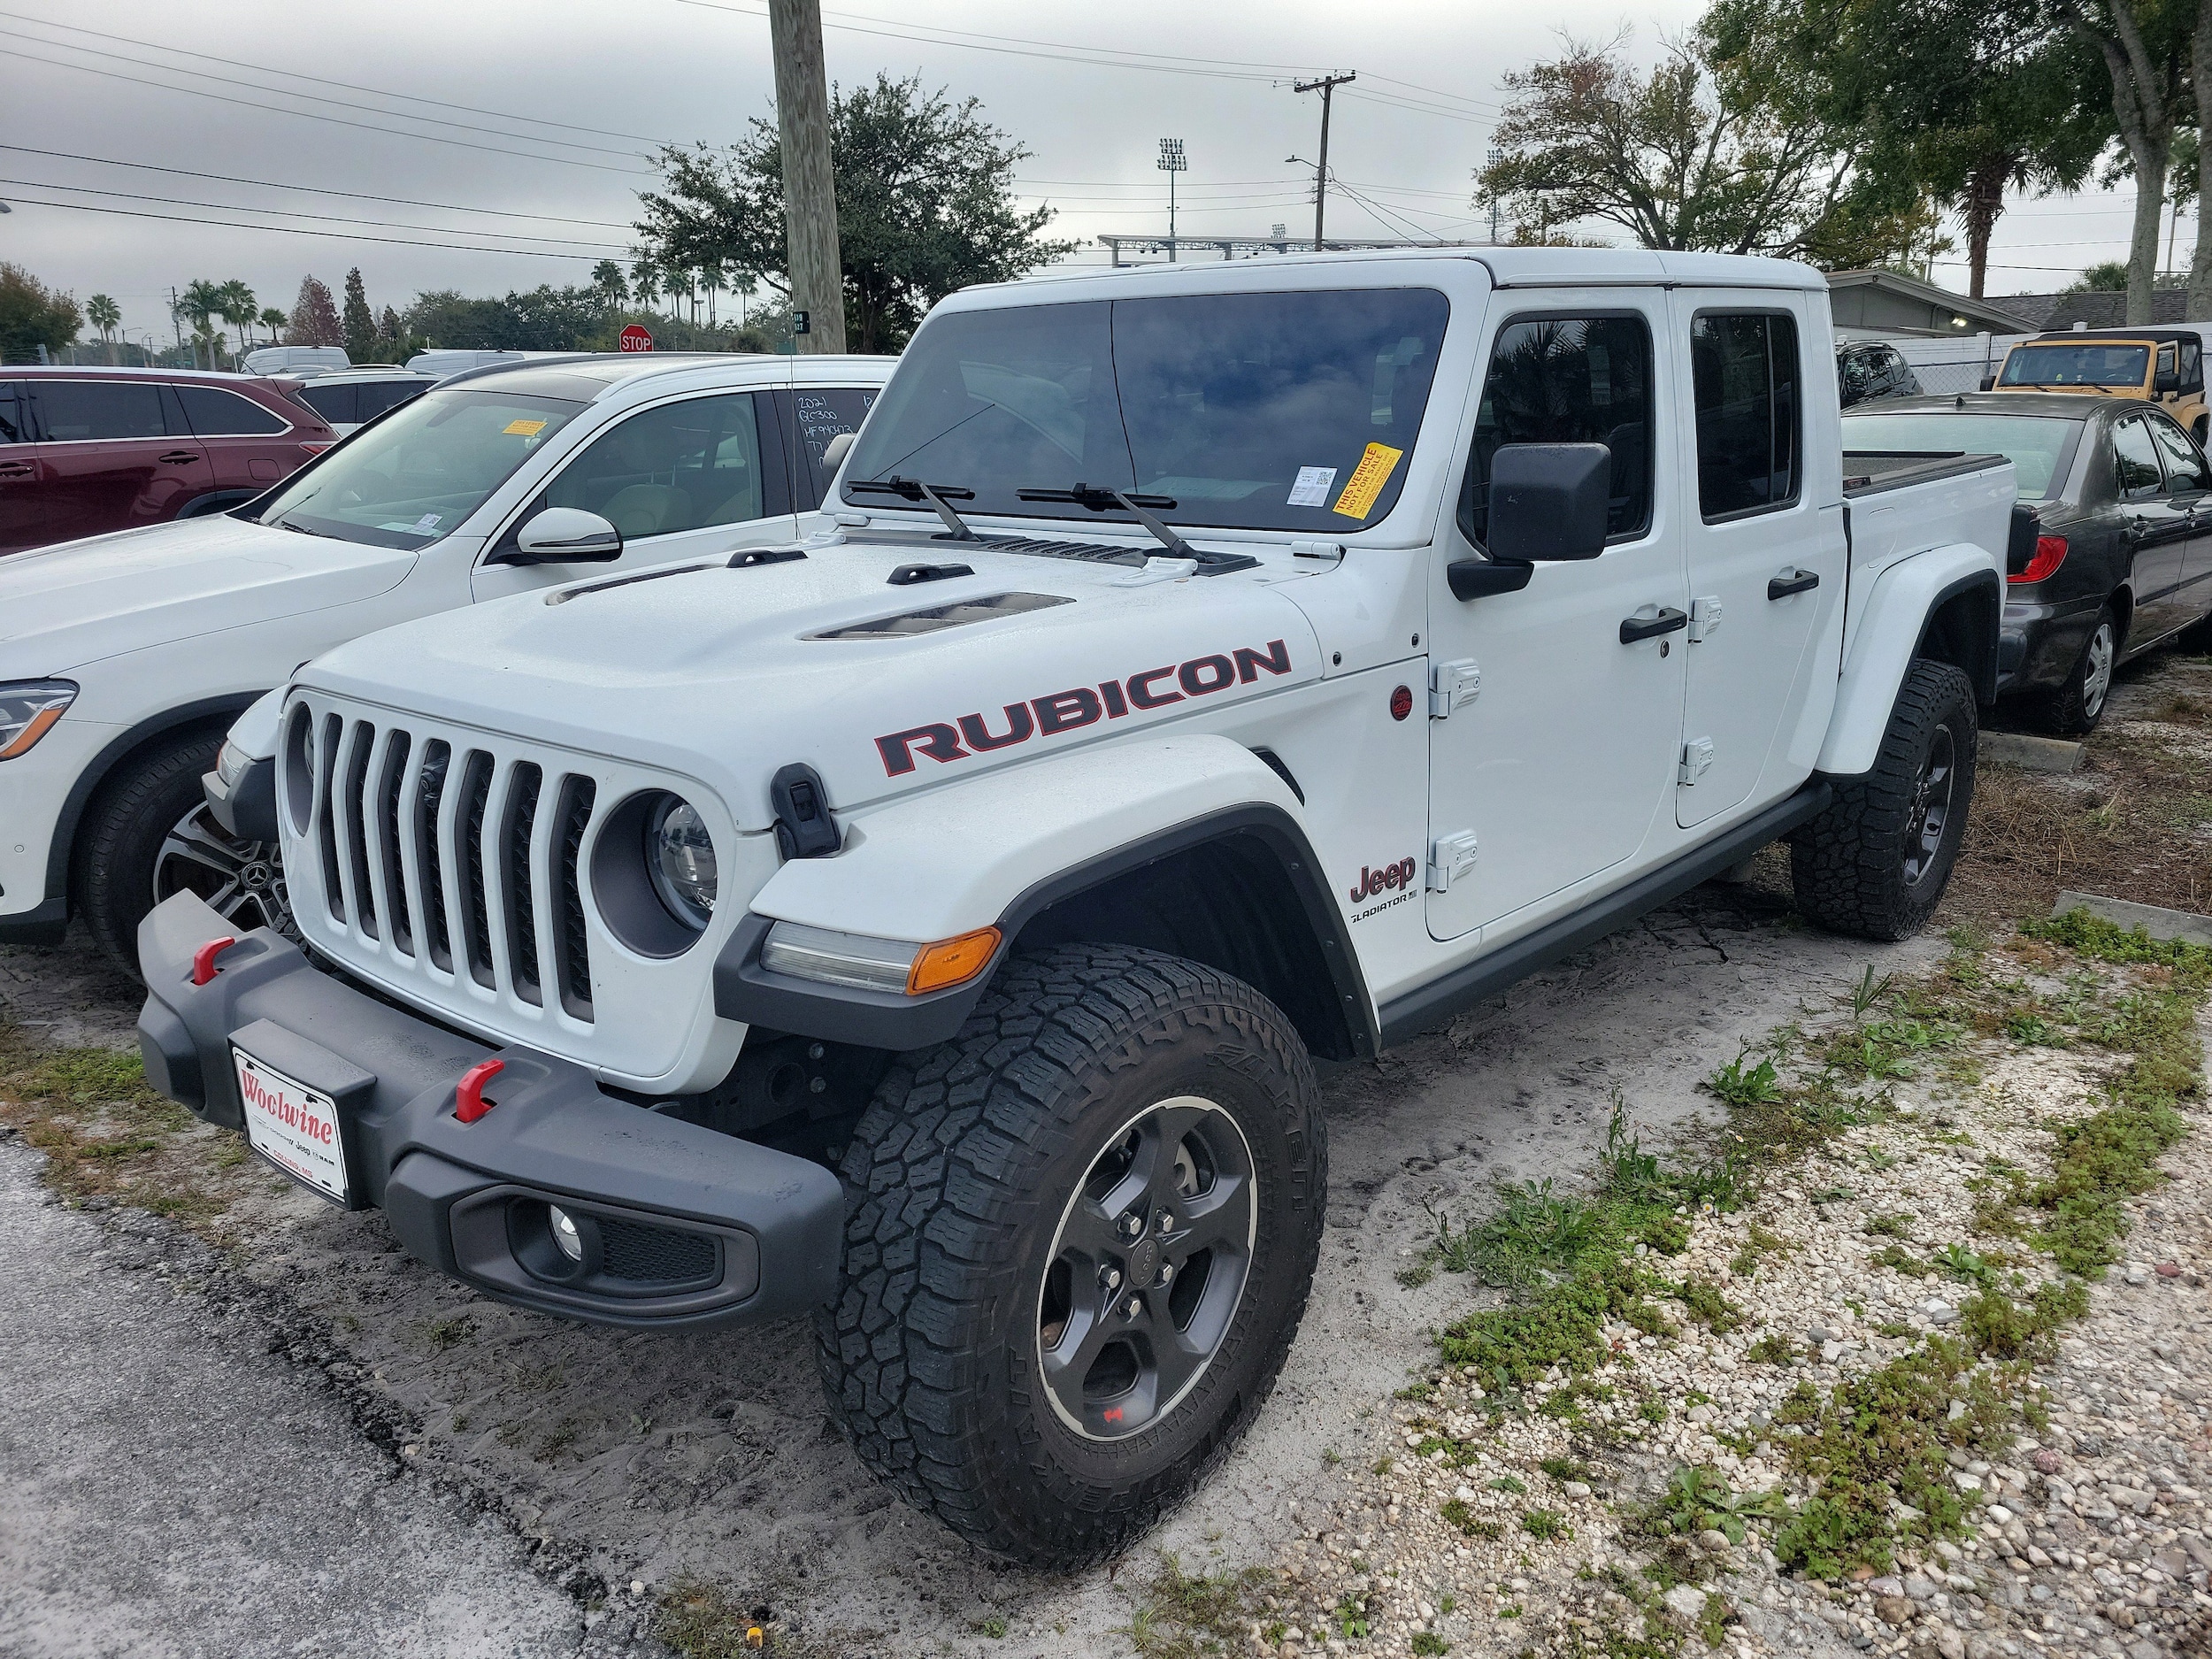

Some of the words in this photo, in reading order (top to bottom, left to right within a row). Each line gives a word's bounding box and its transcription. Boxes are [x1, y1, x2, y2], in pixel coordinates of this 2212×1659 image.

[622, 335, 651, 350] STOP
[798, 396, 827, 408] 2021
[799, 410, 838, 422] GLC300
[1336, 489, 1354, 510] THIS
[1349, 448, 1377, 488] VEHICLE
[1346, 494, 1359, 511] NOT
[1356, 475, 1370, 492] FOR
[1368, 453, 1383, 474] SALE
[874, 639, 1292, 777] RUBICON
[1350, 856, 1416, 902] Jeep
[242, 1069, 333, 1144] Woolwine
[296, 1141, 311, 1157] Jeep
